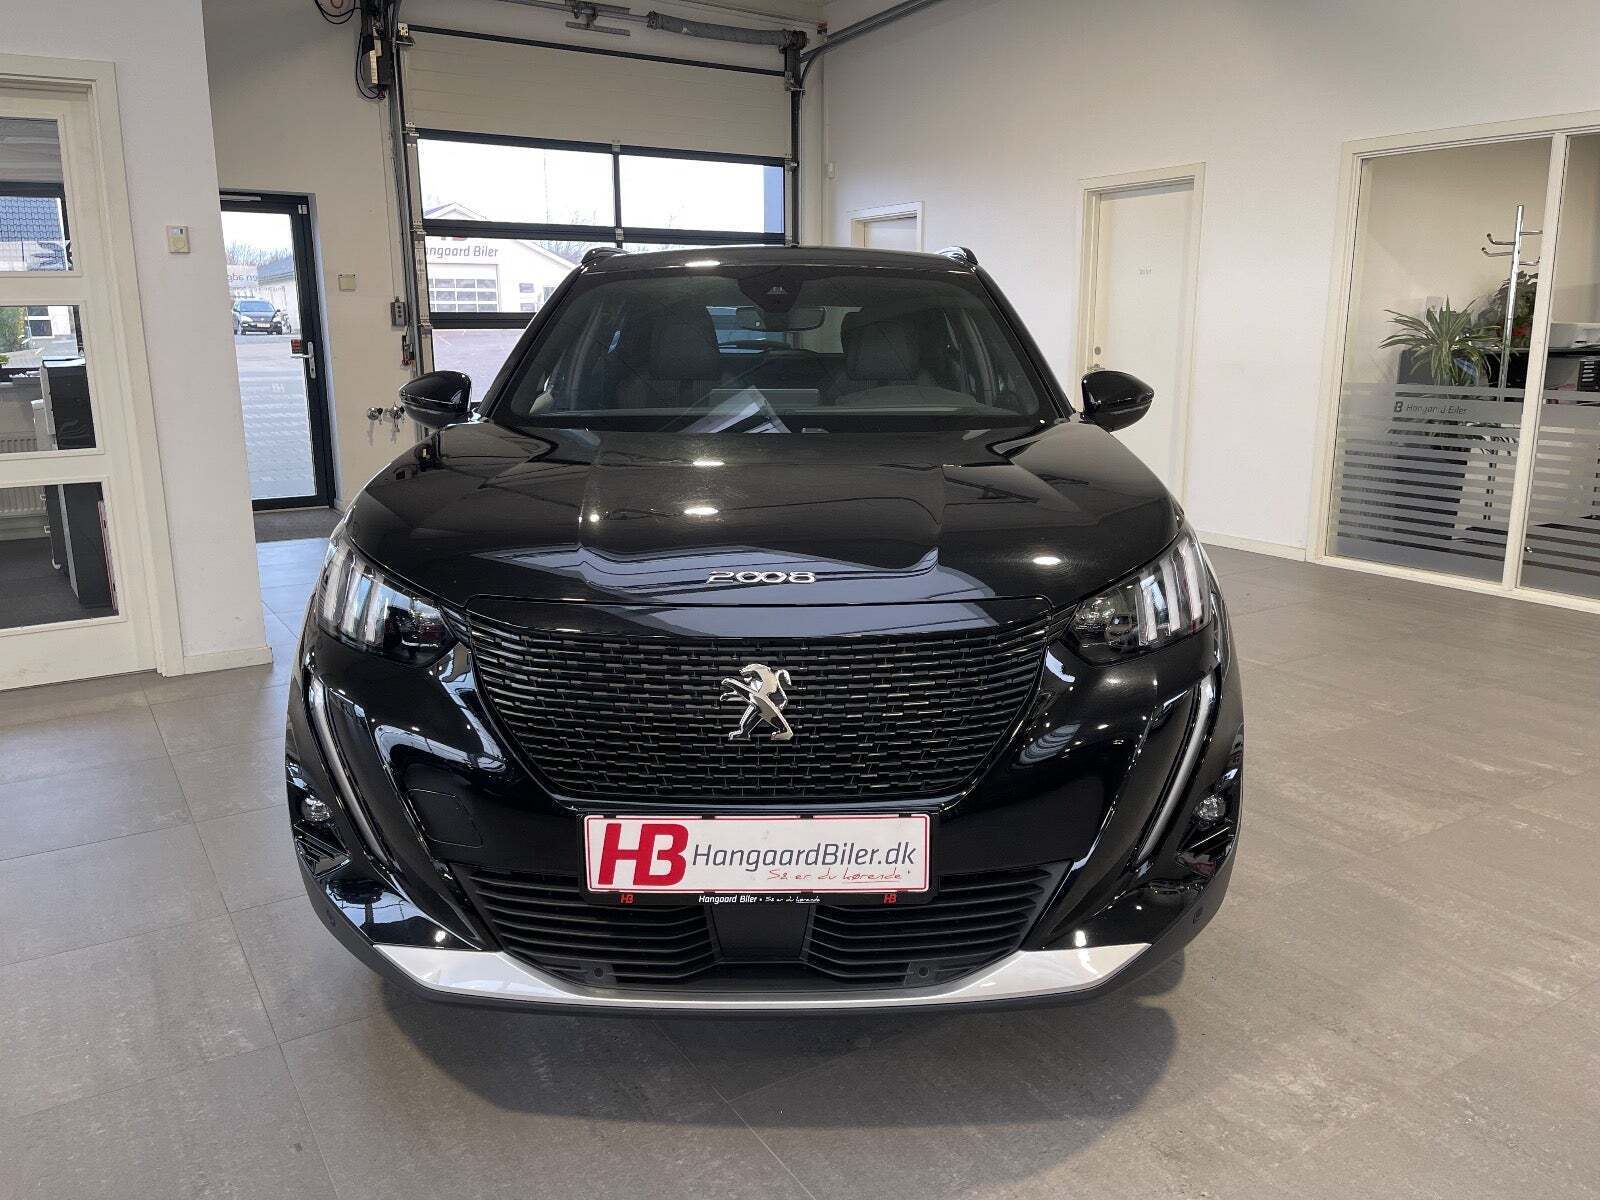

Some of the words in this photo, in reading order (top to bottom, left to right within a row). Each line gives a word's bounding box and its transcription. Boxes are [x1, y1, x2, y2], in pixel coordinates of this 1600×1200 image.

[473, 245, 499, 257] Biler
[705, 570, 817, 584] 2008
[597, 822, 690, 887] HB
[692, 841, 917, 872] HangaardBiler.dk
[620, 893, 634, 904] HB
[698, 894, 738, 905] Hangaard
[739, 894, 758, 903] Biler
[883, 893, 897, 904] HB
